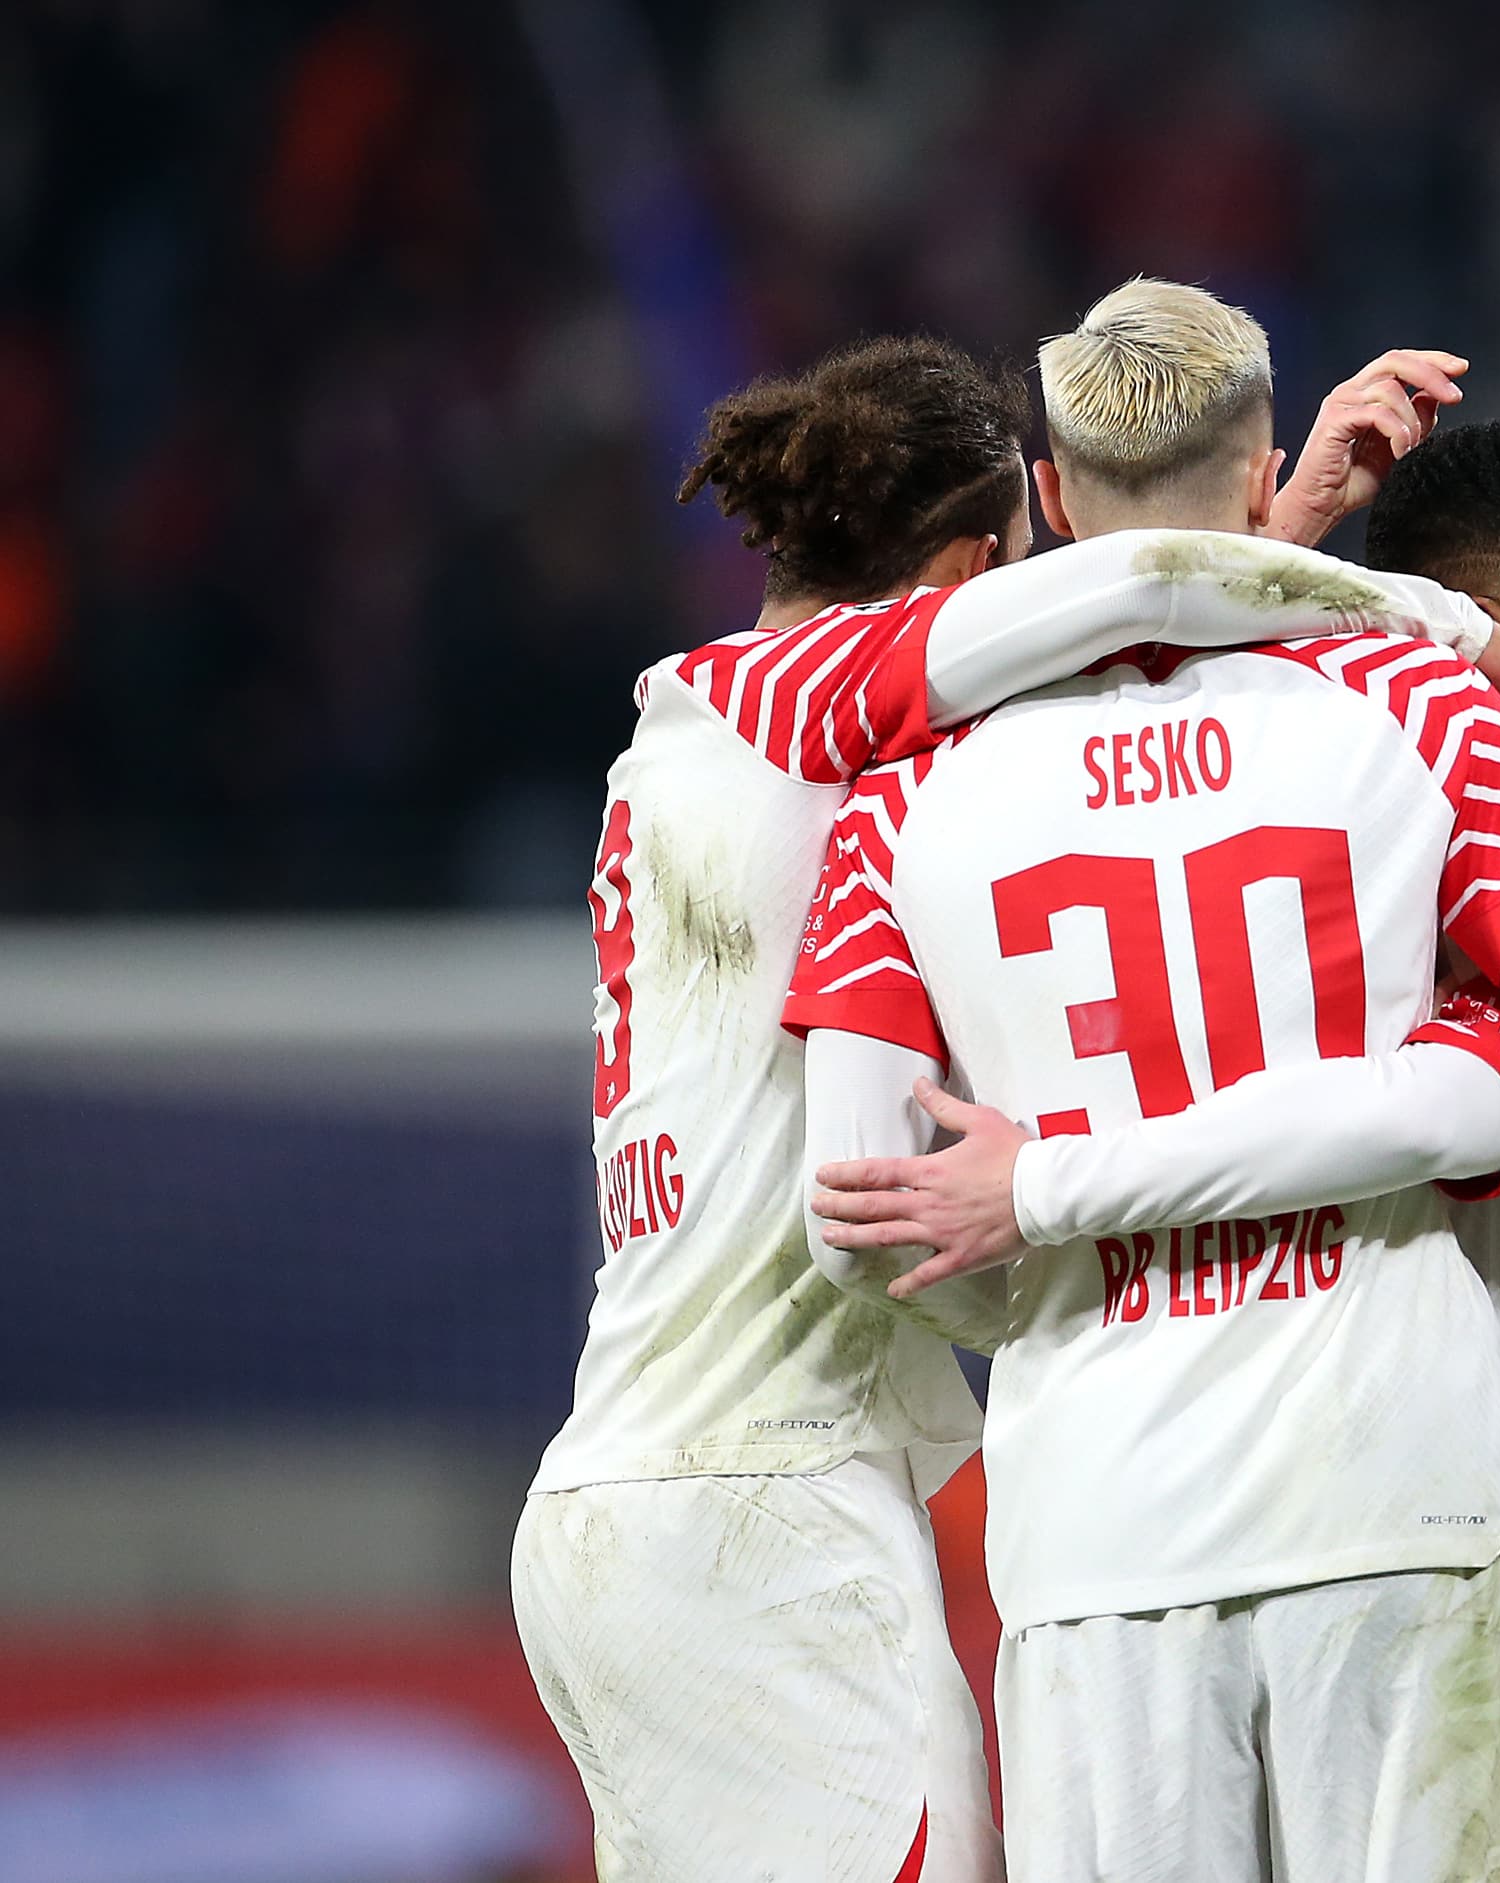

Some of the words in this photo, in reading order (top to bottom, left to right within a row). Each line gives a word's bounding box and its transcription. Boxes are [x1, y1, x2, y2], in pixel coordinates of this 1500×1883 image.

[1083, 717, 1232, 810] SESKO
[990, 825, 1367, 1140] 30
[1095, 1231, 1156, 1328] RB
[1168, 1203, 1345, 1318] LEIPZIG
